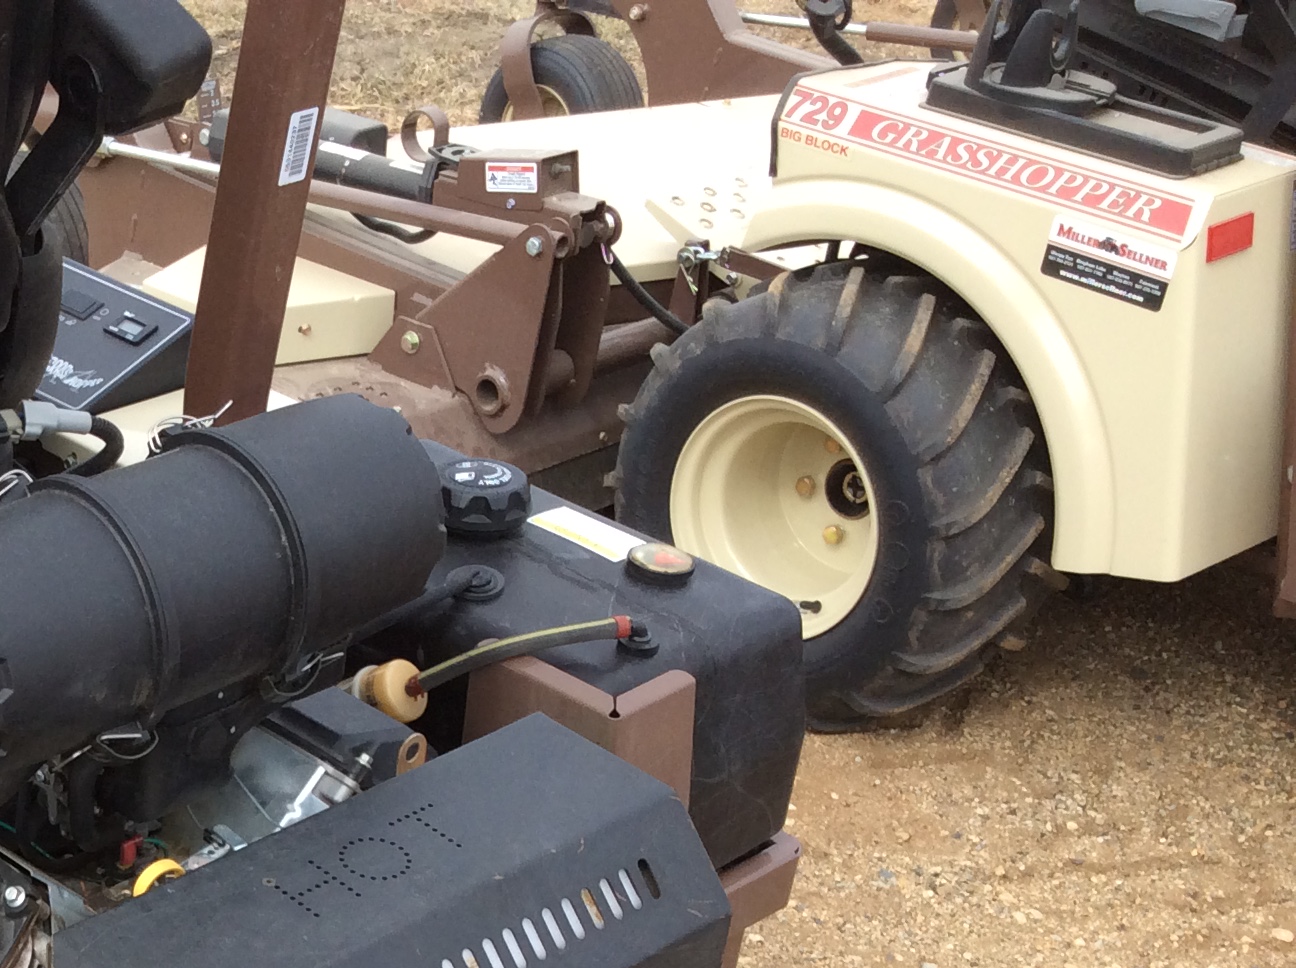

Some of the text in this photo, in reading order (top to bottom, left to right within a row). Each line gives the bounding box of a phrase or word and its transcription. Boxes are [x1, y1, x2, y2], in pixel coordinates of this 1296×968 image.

[781, 127, 849, 157] BIG BLOCK
[785, 88, 1163, 223] 729 GRASSHOPPER
[1118, 243, 1168, 271] SELLNER
[273, 803, 463, 918] HOT
